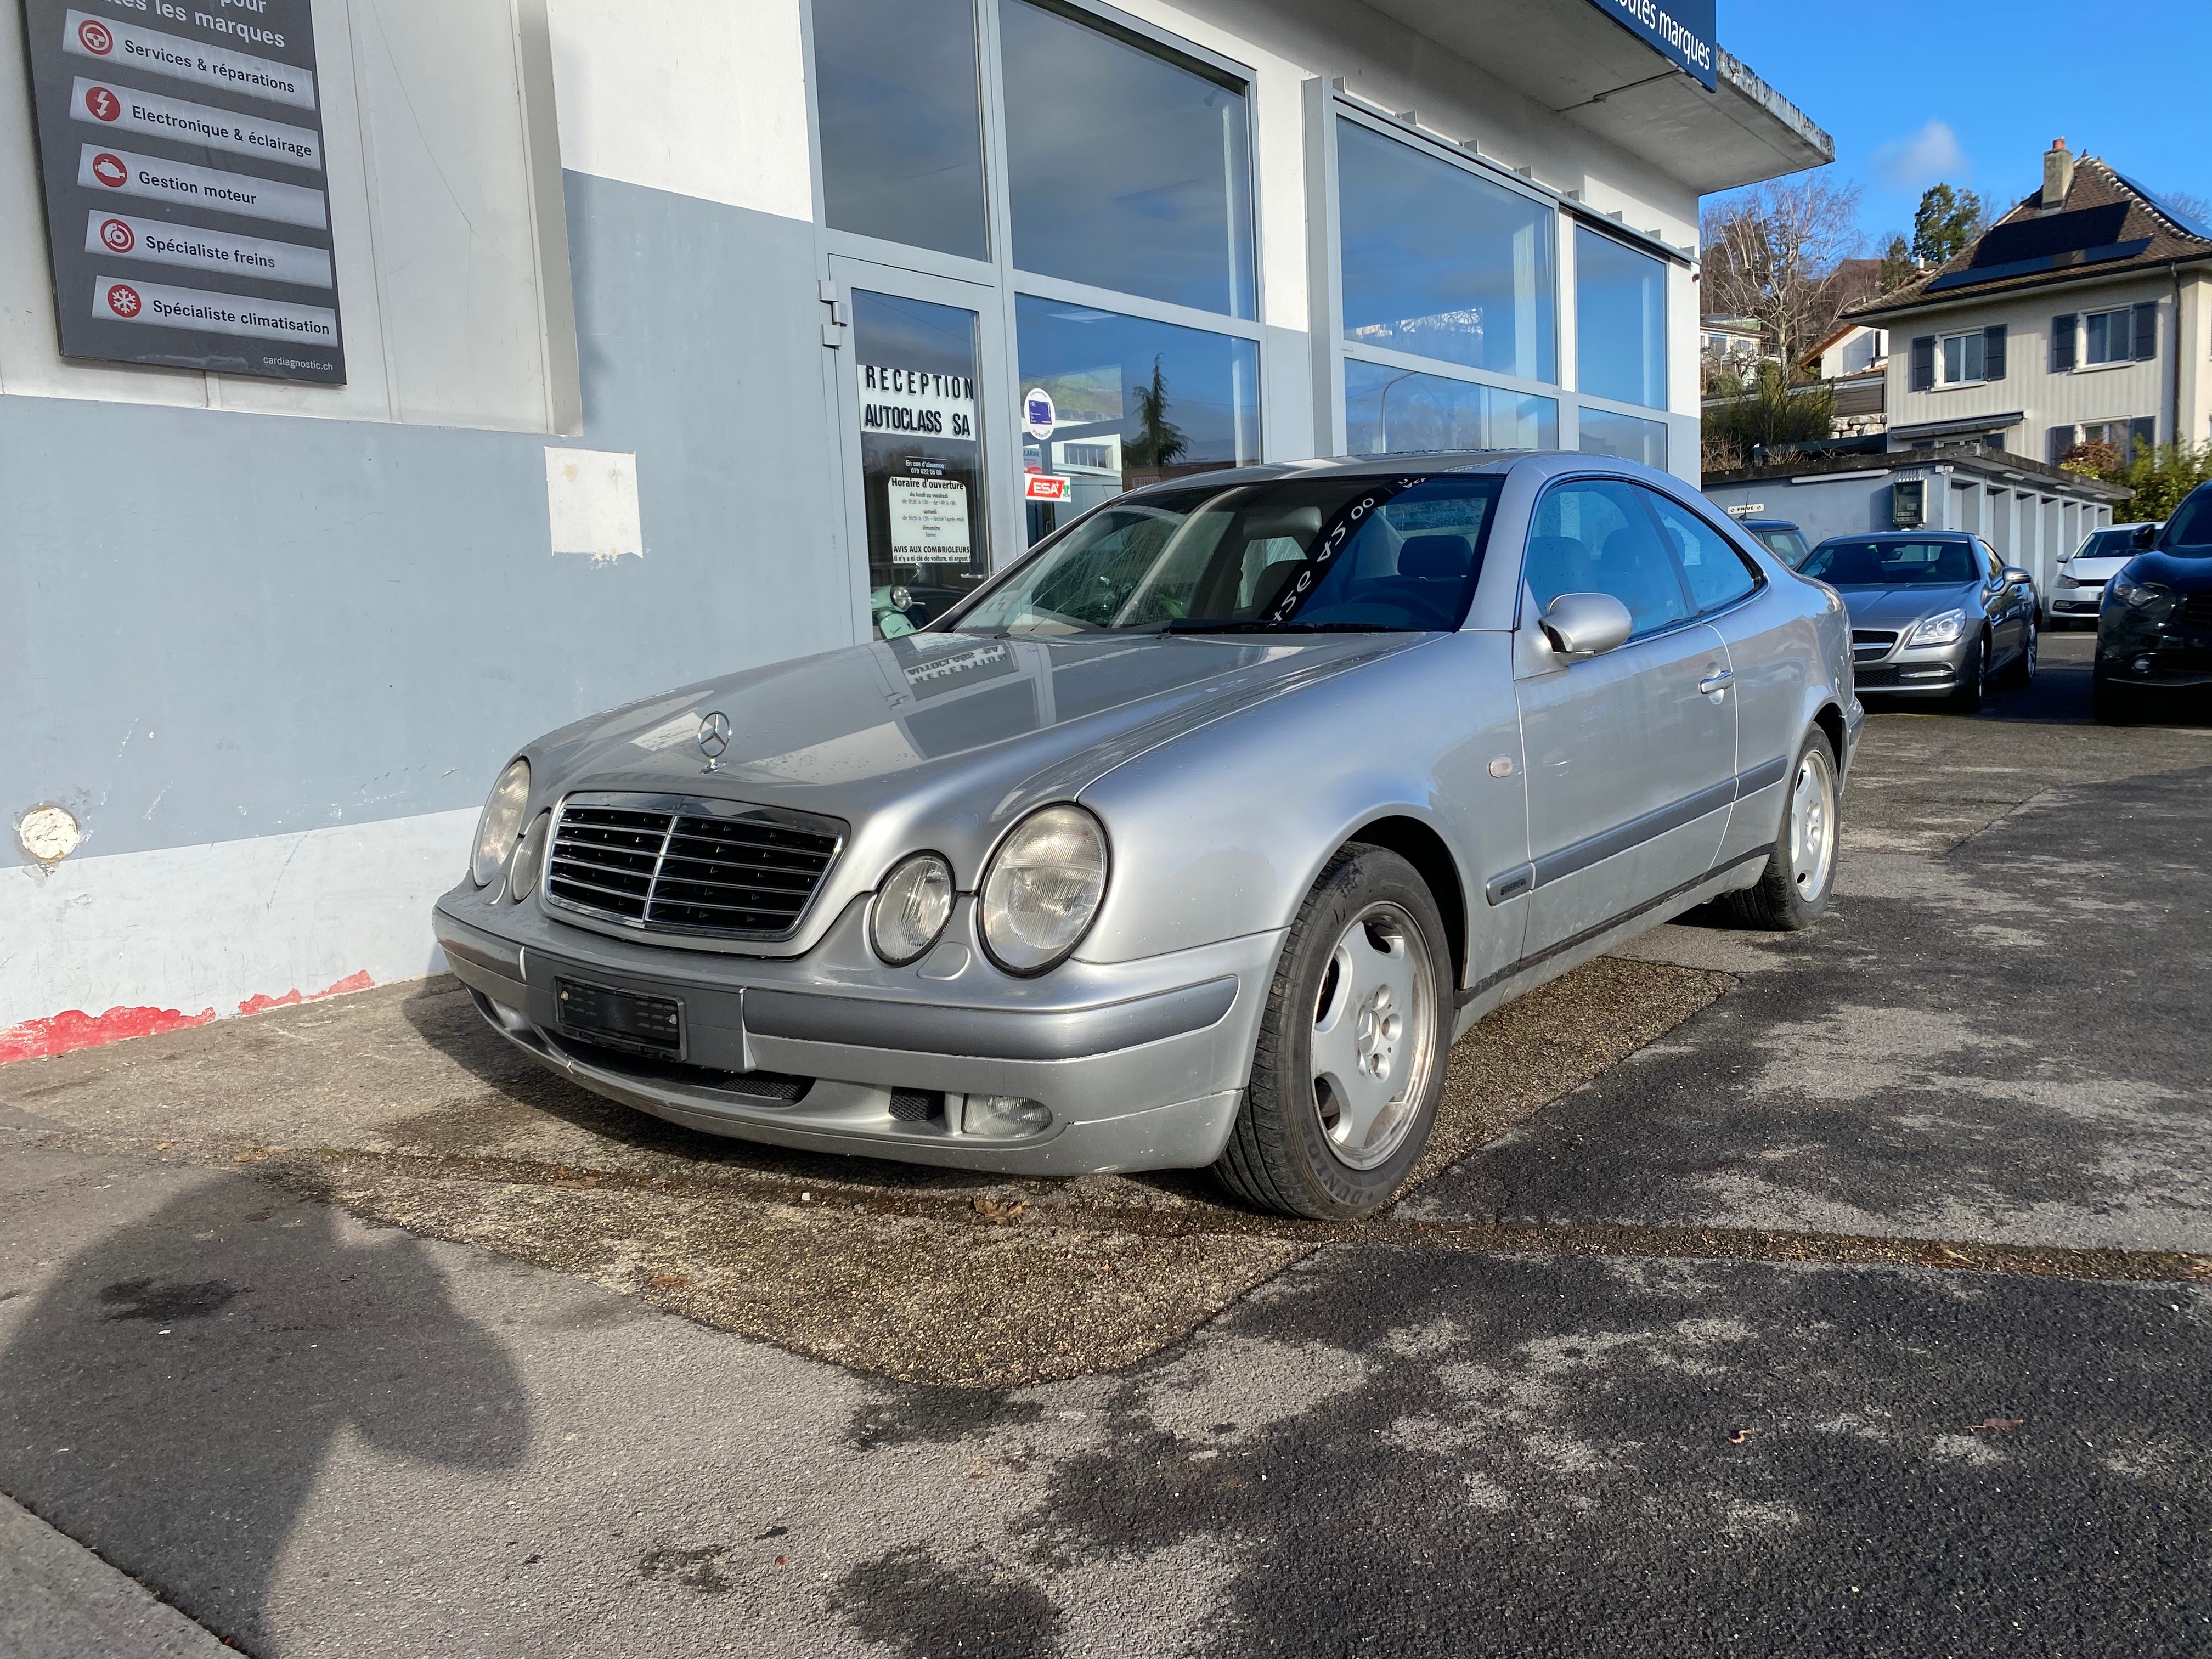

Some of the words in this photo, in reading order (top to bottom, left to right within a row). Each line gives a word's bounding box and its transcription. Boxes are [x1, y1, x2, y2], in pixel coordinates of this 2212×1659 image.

[156, 0, 187, 21] les
[194, 10, 285, 48] marques
[1658, 10, 1711, 71] marques
[125, 40, 192, 68] Services
[198, 58, 207, 71] &
[213, 64, 295, 93] réparations
[132, 105, 229, 138] Electronique
[234, 128, 244, 141] &
[249, 132, 312, 157] éclairage
[139, 171, 198, 194] Gestion
[204, 185, 257, 205] moteur
[146, 236, 229, 261] Spécialiste
[234, 250, 275, 268] freins
[153, 300, 235, 323] Spécialiste
[240, 313, 330, 335] climatisation
[263, 357, 334, 371] cardiagnostic.ch
[866, 365, 974, 400] RECEPTION
[865, 403, 943, 433] AUTOCLASS
[952, 413, 971, 436] SA
[891, 478, 920, 488] Horaire
[922, 479, 964, 490] d'ouverture
